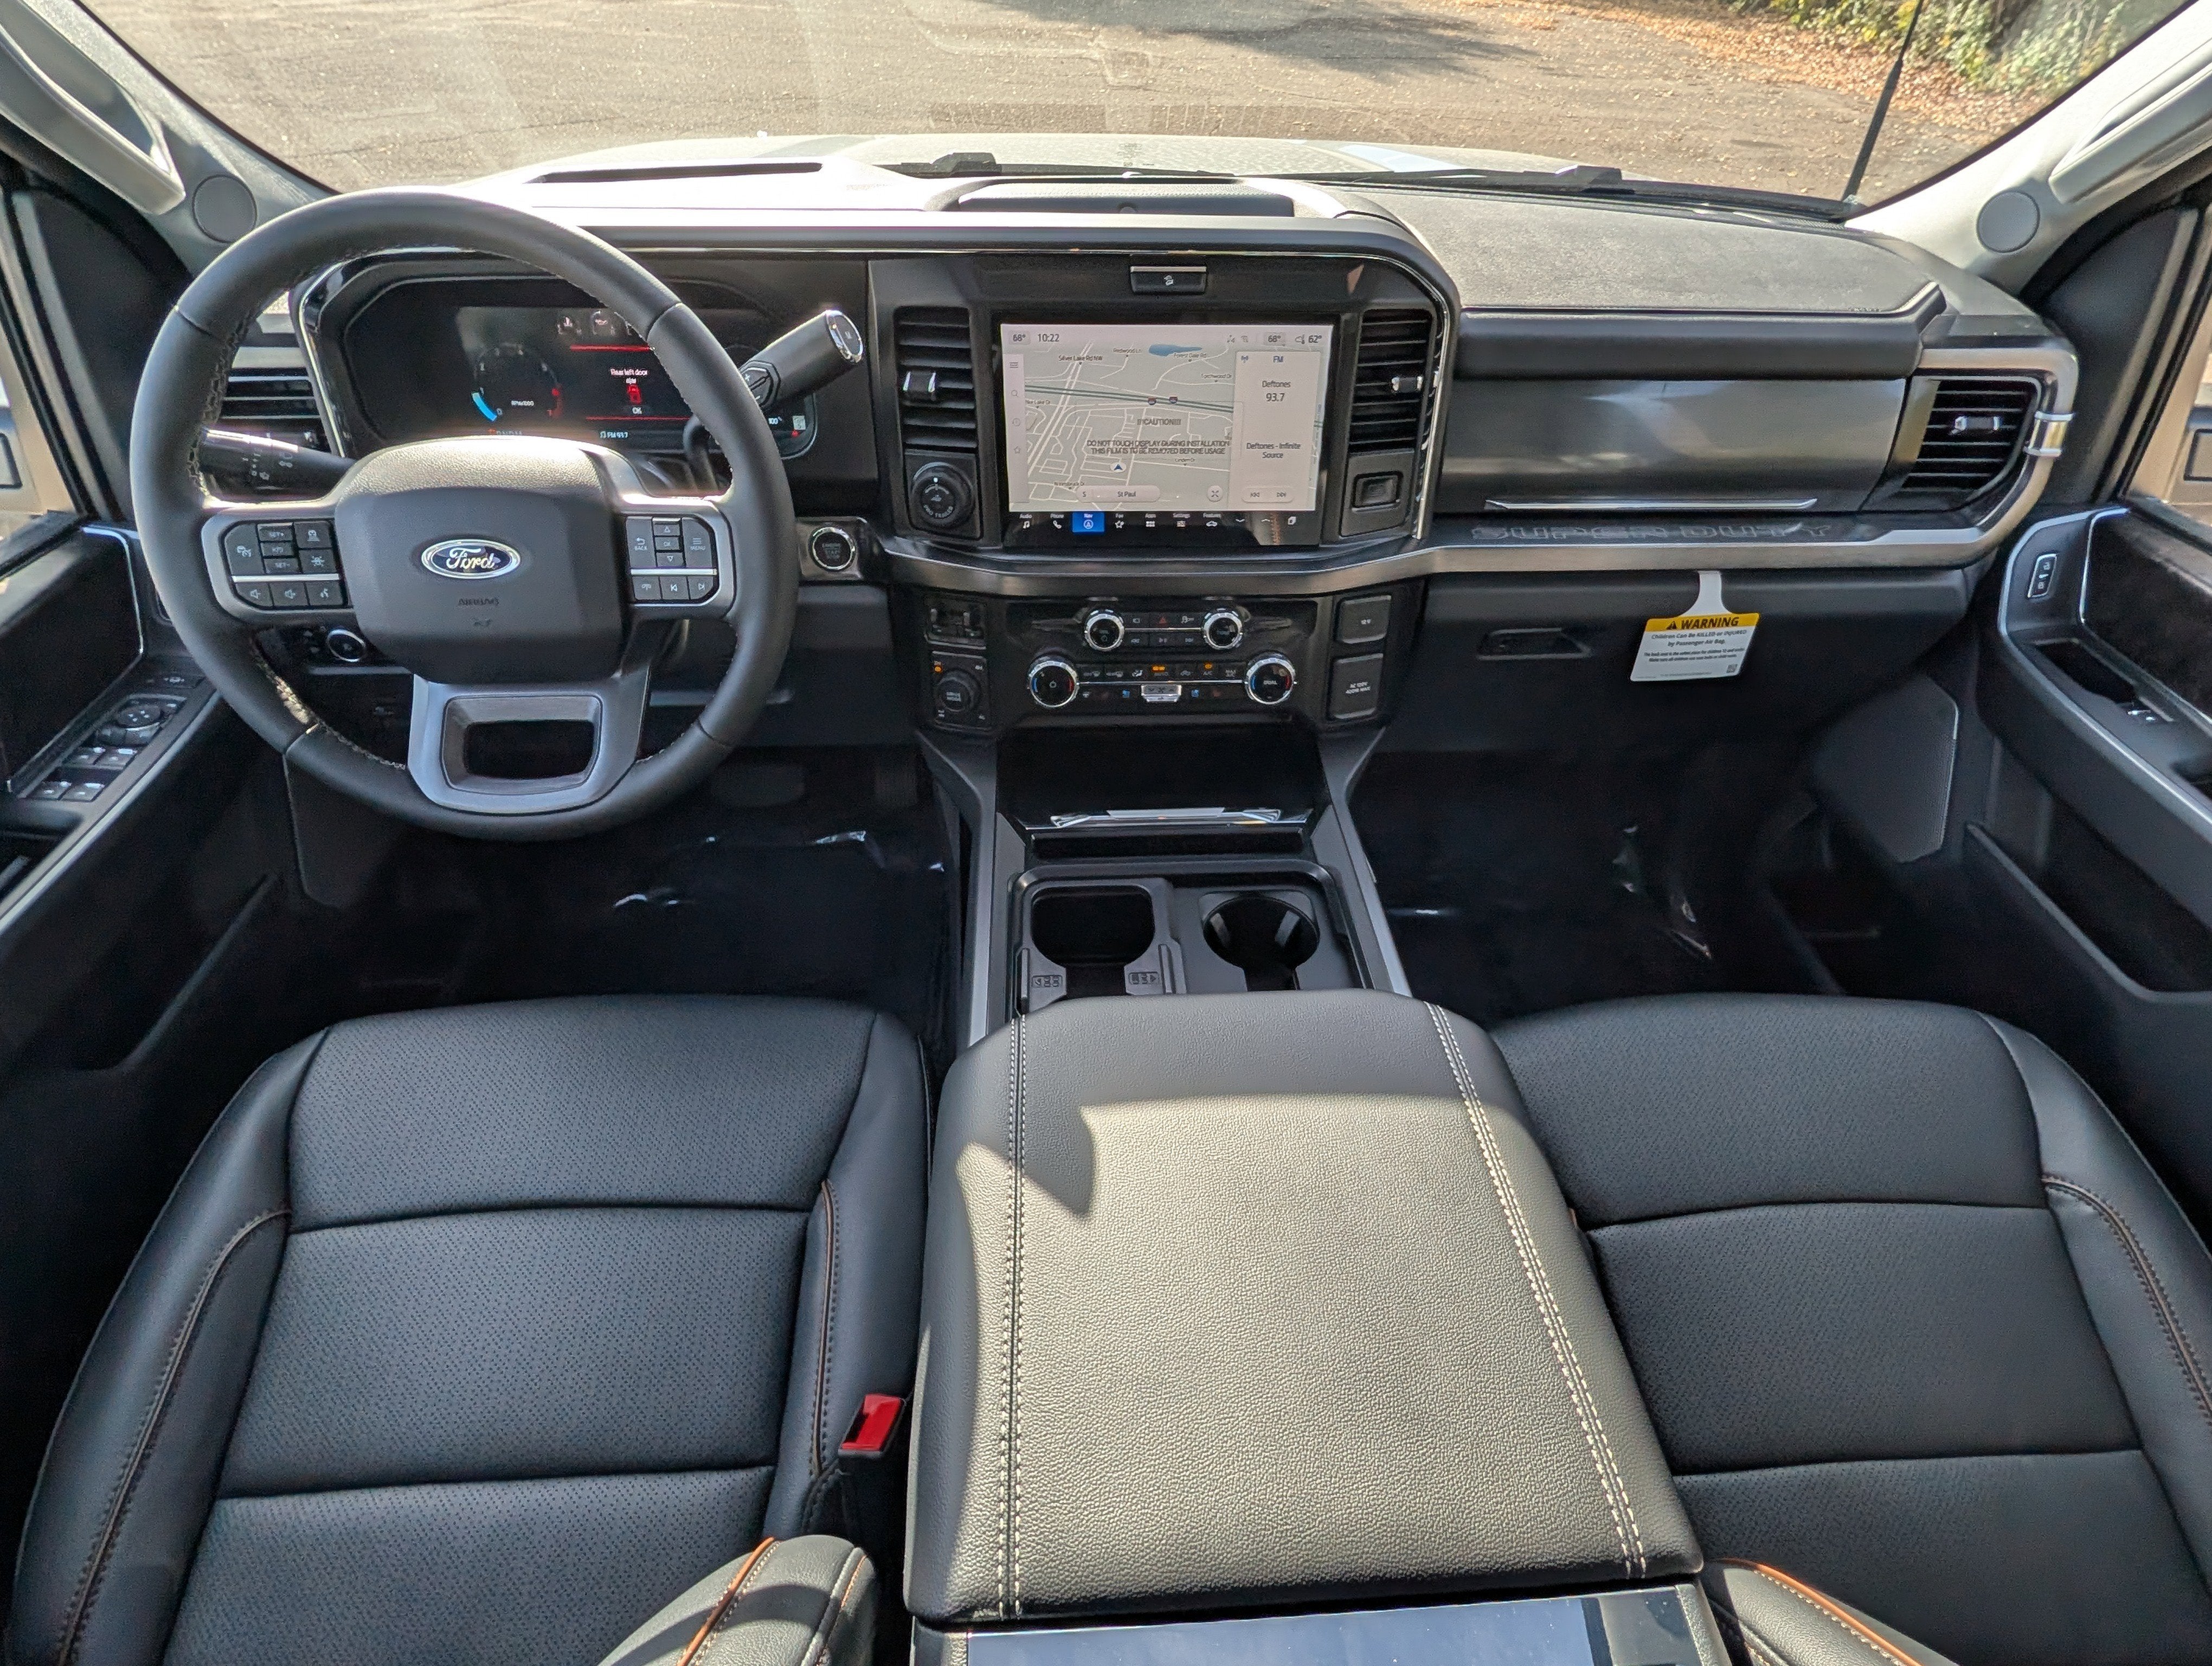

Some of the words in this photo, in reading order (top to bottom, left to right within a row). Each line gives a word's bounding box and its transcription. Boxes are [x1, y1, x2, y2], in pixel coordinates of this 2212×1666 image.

[1038, 333, 1060, 342] 10:22
[1262, 380, 1291, 388] Deftones
[1266, 393, 1285, 402] 93.7
[446, 547, 496, 569] Ford
[1681, 616, 1739, 630] WARNING
